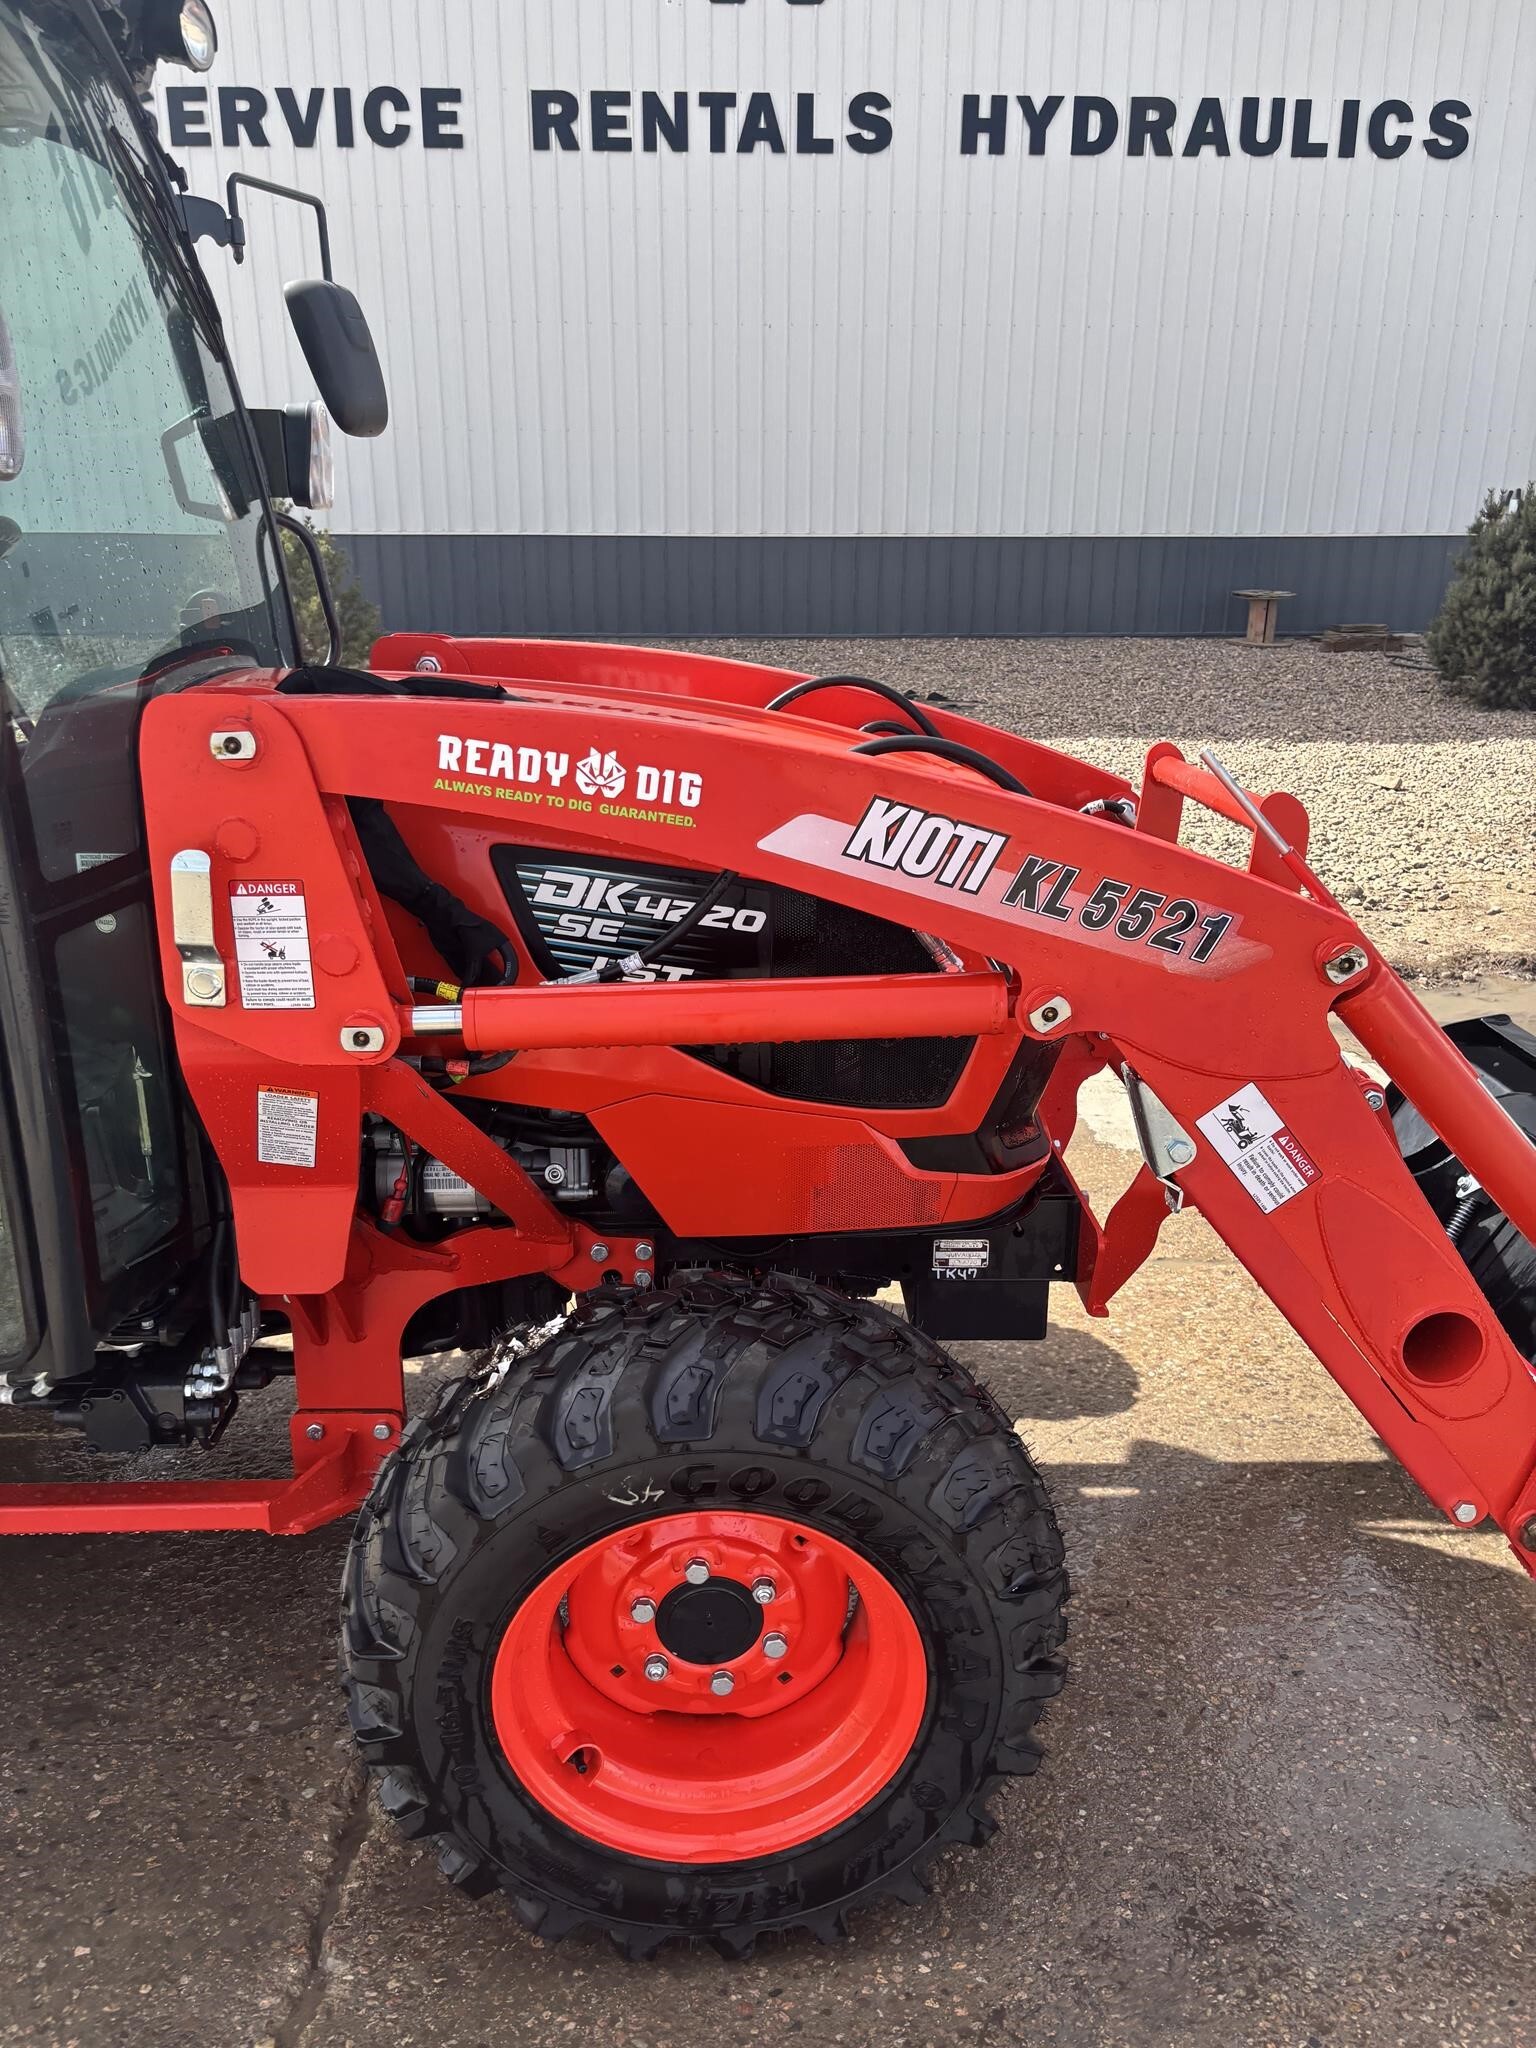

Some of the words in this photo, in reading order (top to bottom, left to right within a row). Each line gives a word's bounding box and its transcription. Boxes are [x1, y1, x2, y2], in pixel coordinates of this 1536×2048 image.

[142, 86, 463, 149] ERVICE
[531, 90, 893, 154] RENTALS
[960, 95, 1472, 160] HYDRAULICS
[437, 734, 570, 787] READY
[636, 765, 703, 809] DIG
[434, 778, 492, 797] ALWAYS
[496, 788, 542, 804] READY
[546, 795, 564, 808] TO
[568, 799, 592, 812] DIG
[599, 803, 697, 828] GUARANTEED.
[248, 883, 297, 895] DANGER
[844, 795, 1009, 894] KIOTI
[1001, 855, 1082, 921] KL
[1079, 878, 1234, 964] 5521
[553, 913, 625, 943] SE
[273, 1087, 311, 1097] WARNING
[1283, 1141, 1316, 1178] DANGER
[669, 1464, 990, 1740] GOODYEAR
